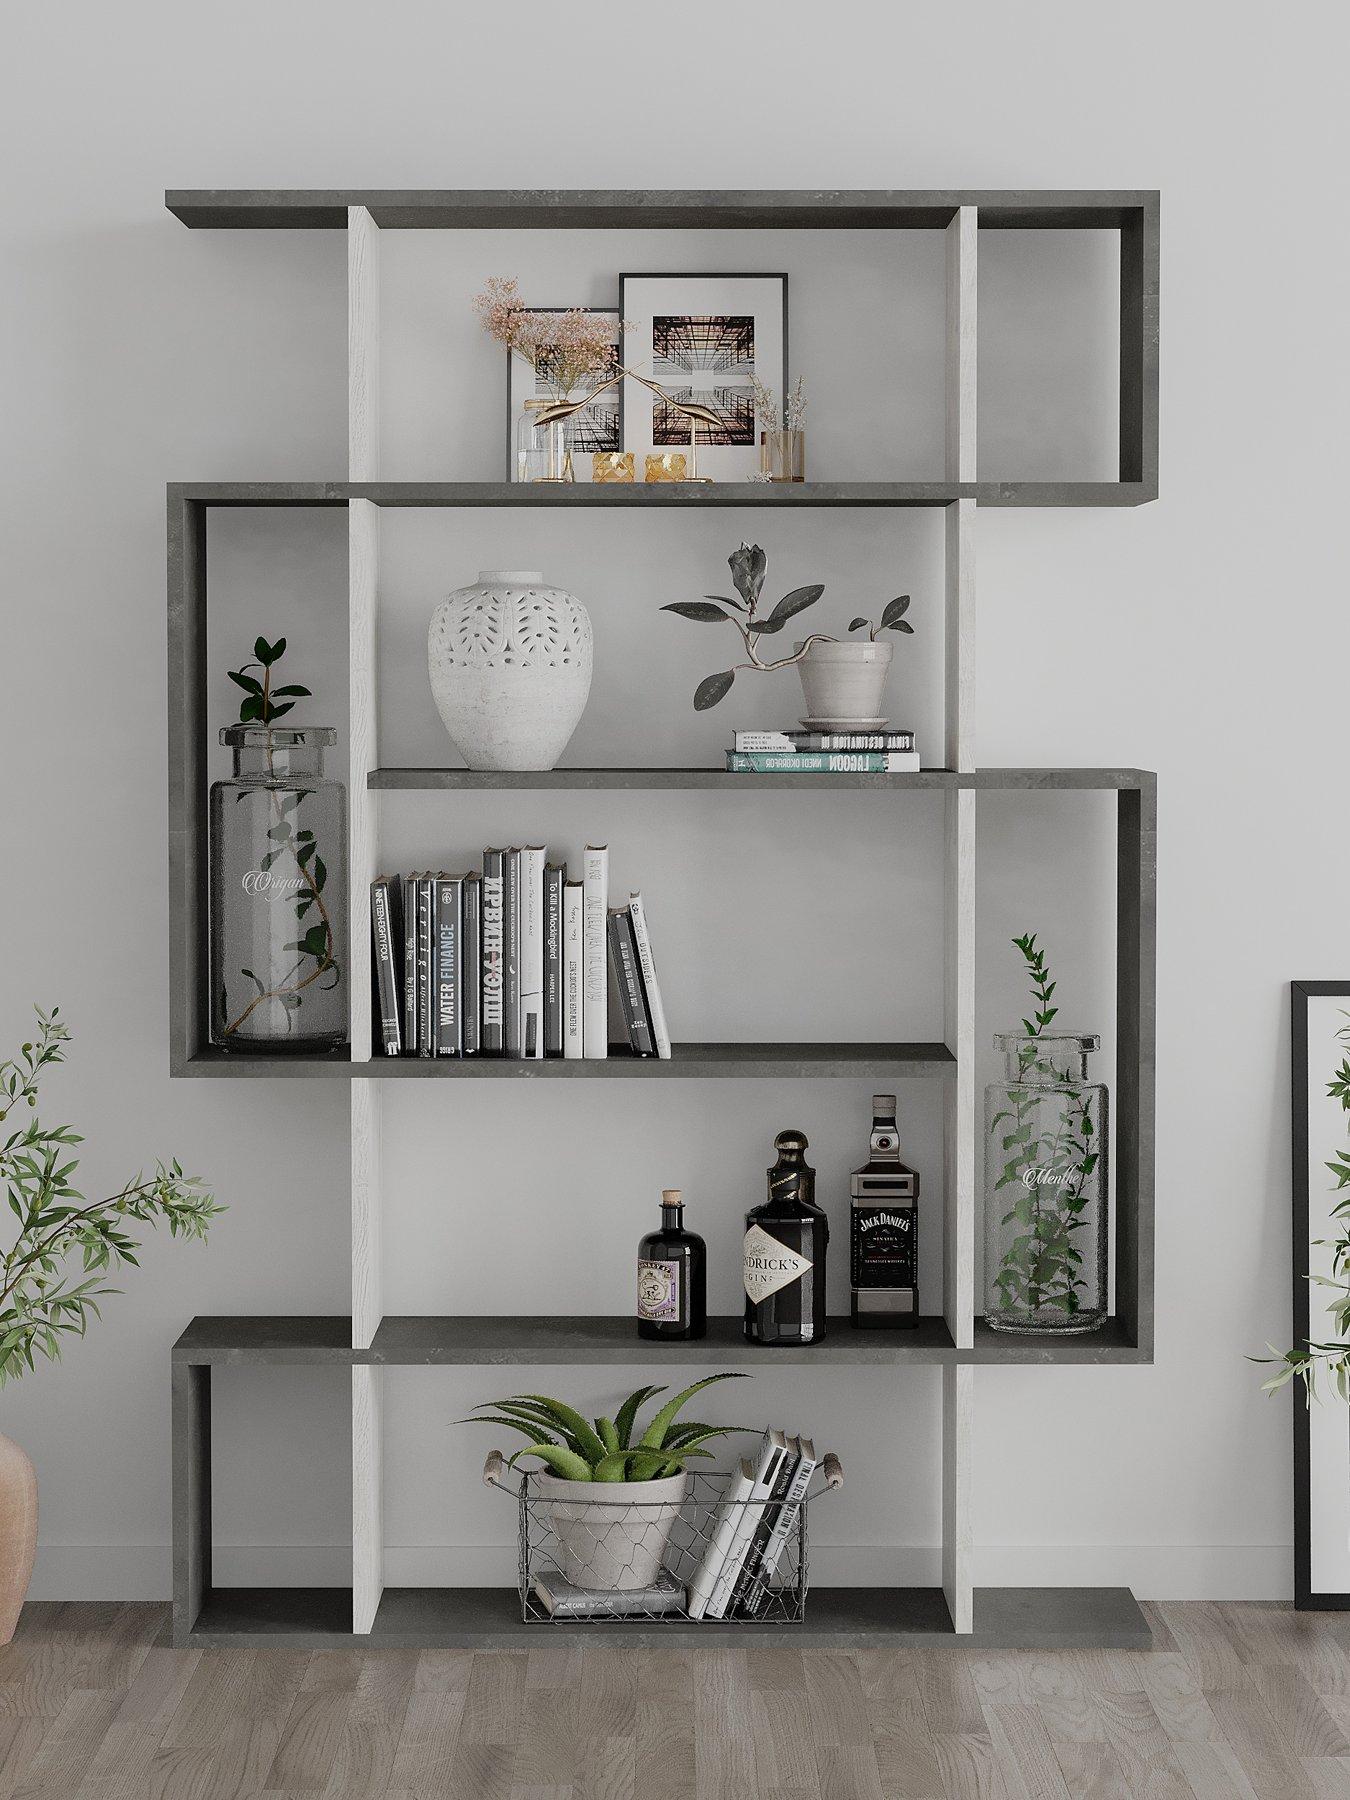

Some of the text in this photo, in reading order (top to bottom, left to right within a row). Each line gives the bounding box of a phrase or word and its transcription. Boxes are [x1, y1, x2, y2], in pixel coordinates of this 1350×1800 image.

[242, 871, 304, 902] Origan
[549, 882, 558, 891] To
[549, 893, 558, 905] Kill
[483, 876, 504, 954] ИРВИН
[418, 889, 430, 981] Vertigo
[547, 912, 558, 960] Mockingbird
[380, 944, 389, 961] FOUR
[440, 923, 454, 1026] WATER FINANCE
[860, 1212, 911, 1232] JACK DANIEL'S
[748, 1273, 767, 1282] GIN
[798, 1461, 813, 1481] FINAL
[780, 1483, 805, 1529] DESTNATION
